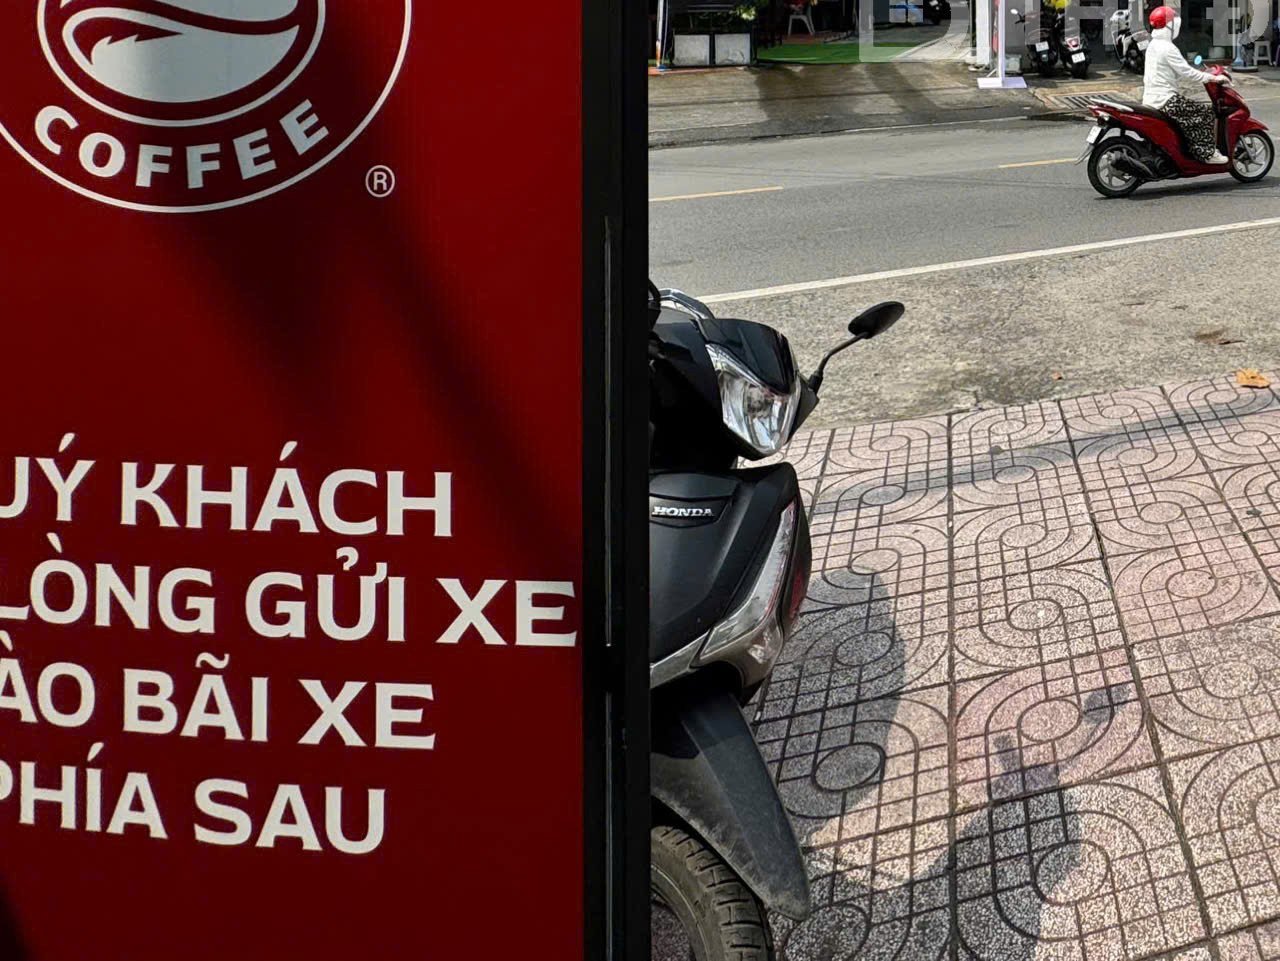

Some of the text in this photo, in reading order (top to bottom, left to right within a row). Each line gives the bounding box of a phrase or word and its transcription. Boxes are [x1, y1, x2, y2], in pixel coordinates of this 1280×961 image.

[35, 99, 329, 189] COFFEE
[120, 441, 453, 537] KHÁCH
[651, 506, 714, 517] HONDA
[244, 546, 406, 642] GỬI
[435, 578, 578, 647] XE
[122, 652, 270, 742] BÃI
[298, 679, 437, 750] XE
[193, 777, 386, 855] SAU
